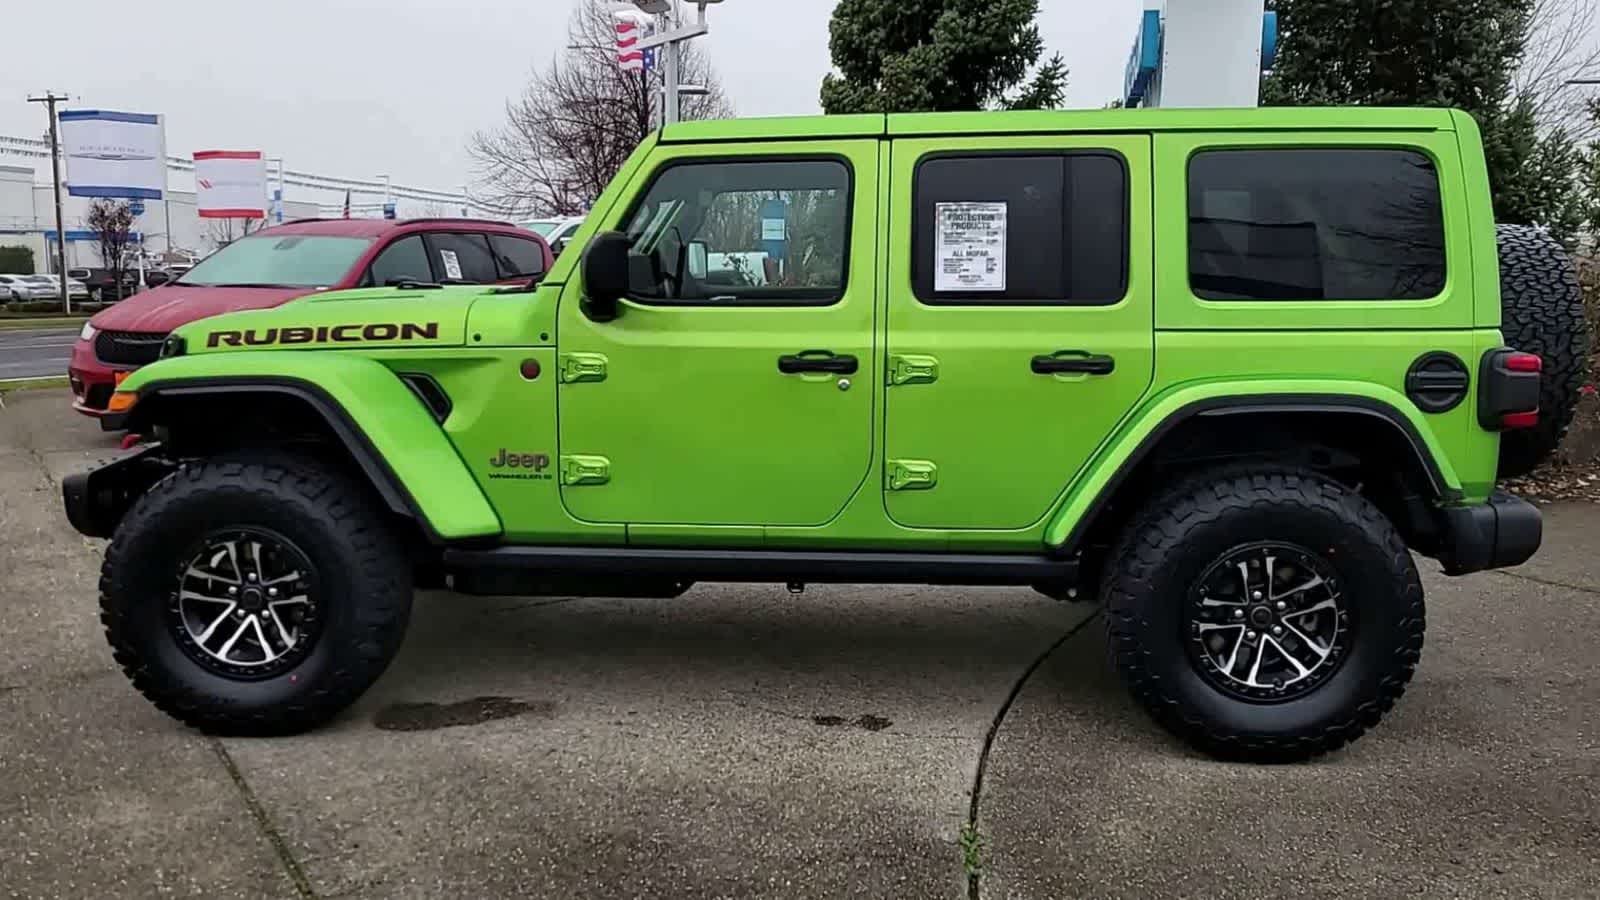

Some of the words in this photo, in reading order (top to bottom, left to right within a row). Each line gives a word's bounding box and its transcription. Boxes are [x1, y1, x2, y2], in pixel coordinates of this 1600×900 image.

[947, 213, 996, 222] PROTECTION
[951, 222, 991, 230] PRODUCTS
[206, 322, 439, 348] RUBICON
[489, 448, 550, 472] Jeep
